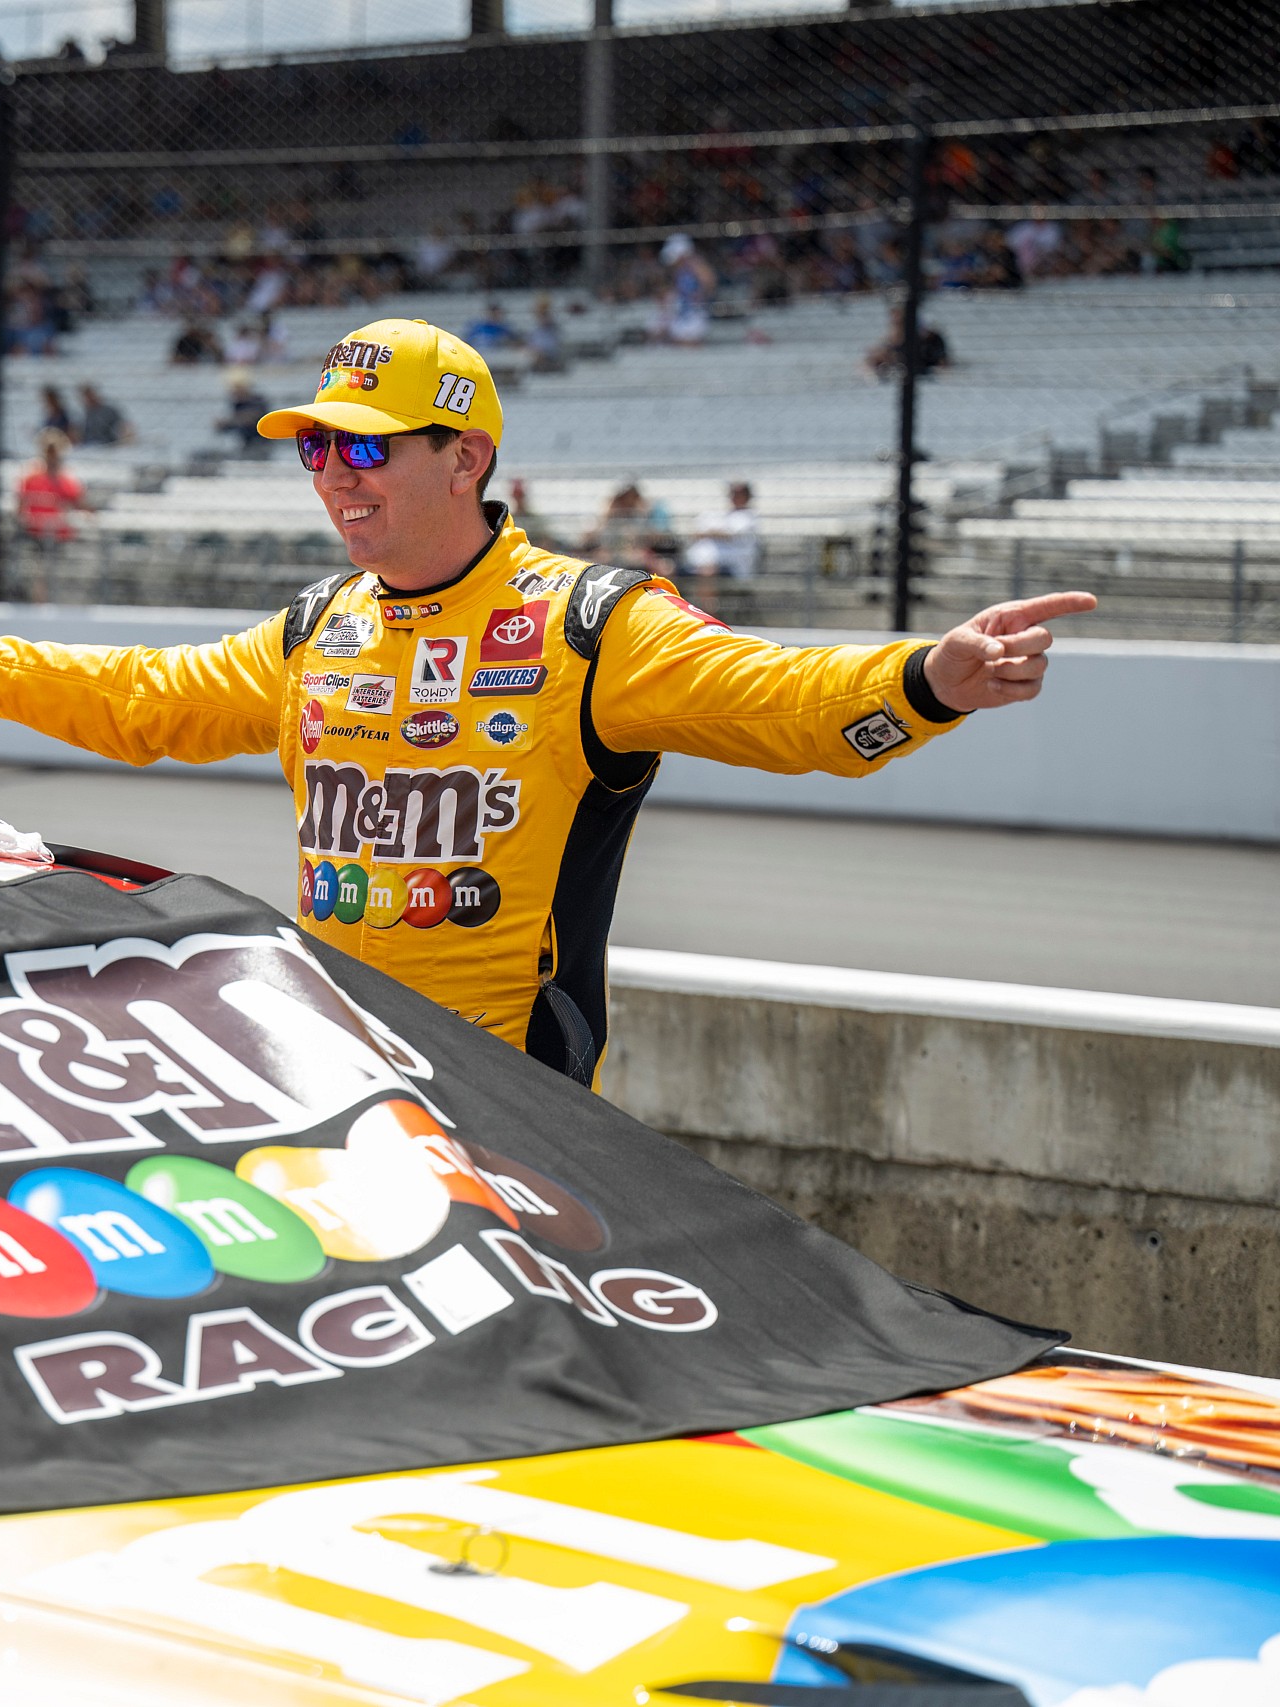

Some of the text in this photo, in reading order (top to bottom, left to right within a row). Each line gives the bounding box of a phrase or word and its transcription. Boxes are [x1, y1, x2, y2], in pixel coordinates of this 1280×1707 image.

[433, 372, 476, 415] 18
[303, 672, 350, 689] SportClips
[473, 668, 538, 687] SNICKERS
[352, 688, 390, 697] INTERSTATE
[352, 696, 387, 705] BATTERIES
[412, 687, 457, 697] ROWDY
[405, 720, 457, 738] Skittles
[476, 722, 528, 734] Pedigree
[315, 880, 328, 901] m
[339, 882, 358, 904] m
[370, 886, 392, 908] m
[410, 887, 435, 908] m
[455, 886, 481, 907] m
[60, 1211, 165, 1262] m
[175, 1198, 277, 1246] m
